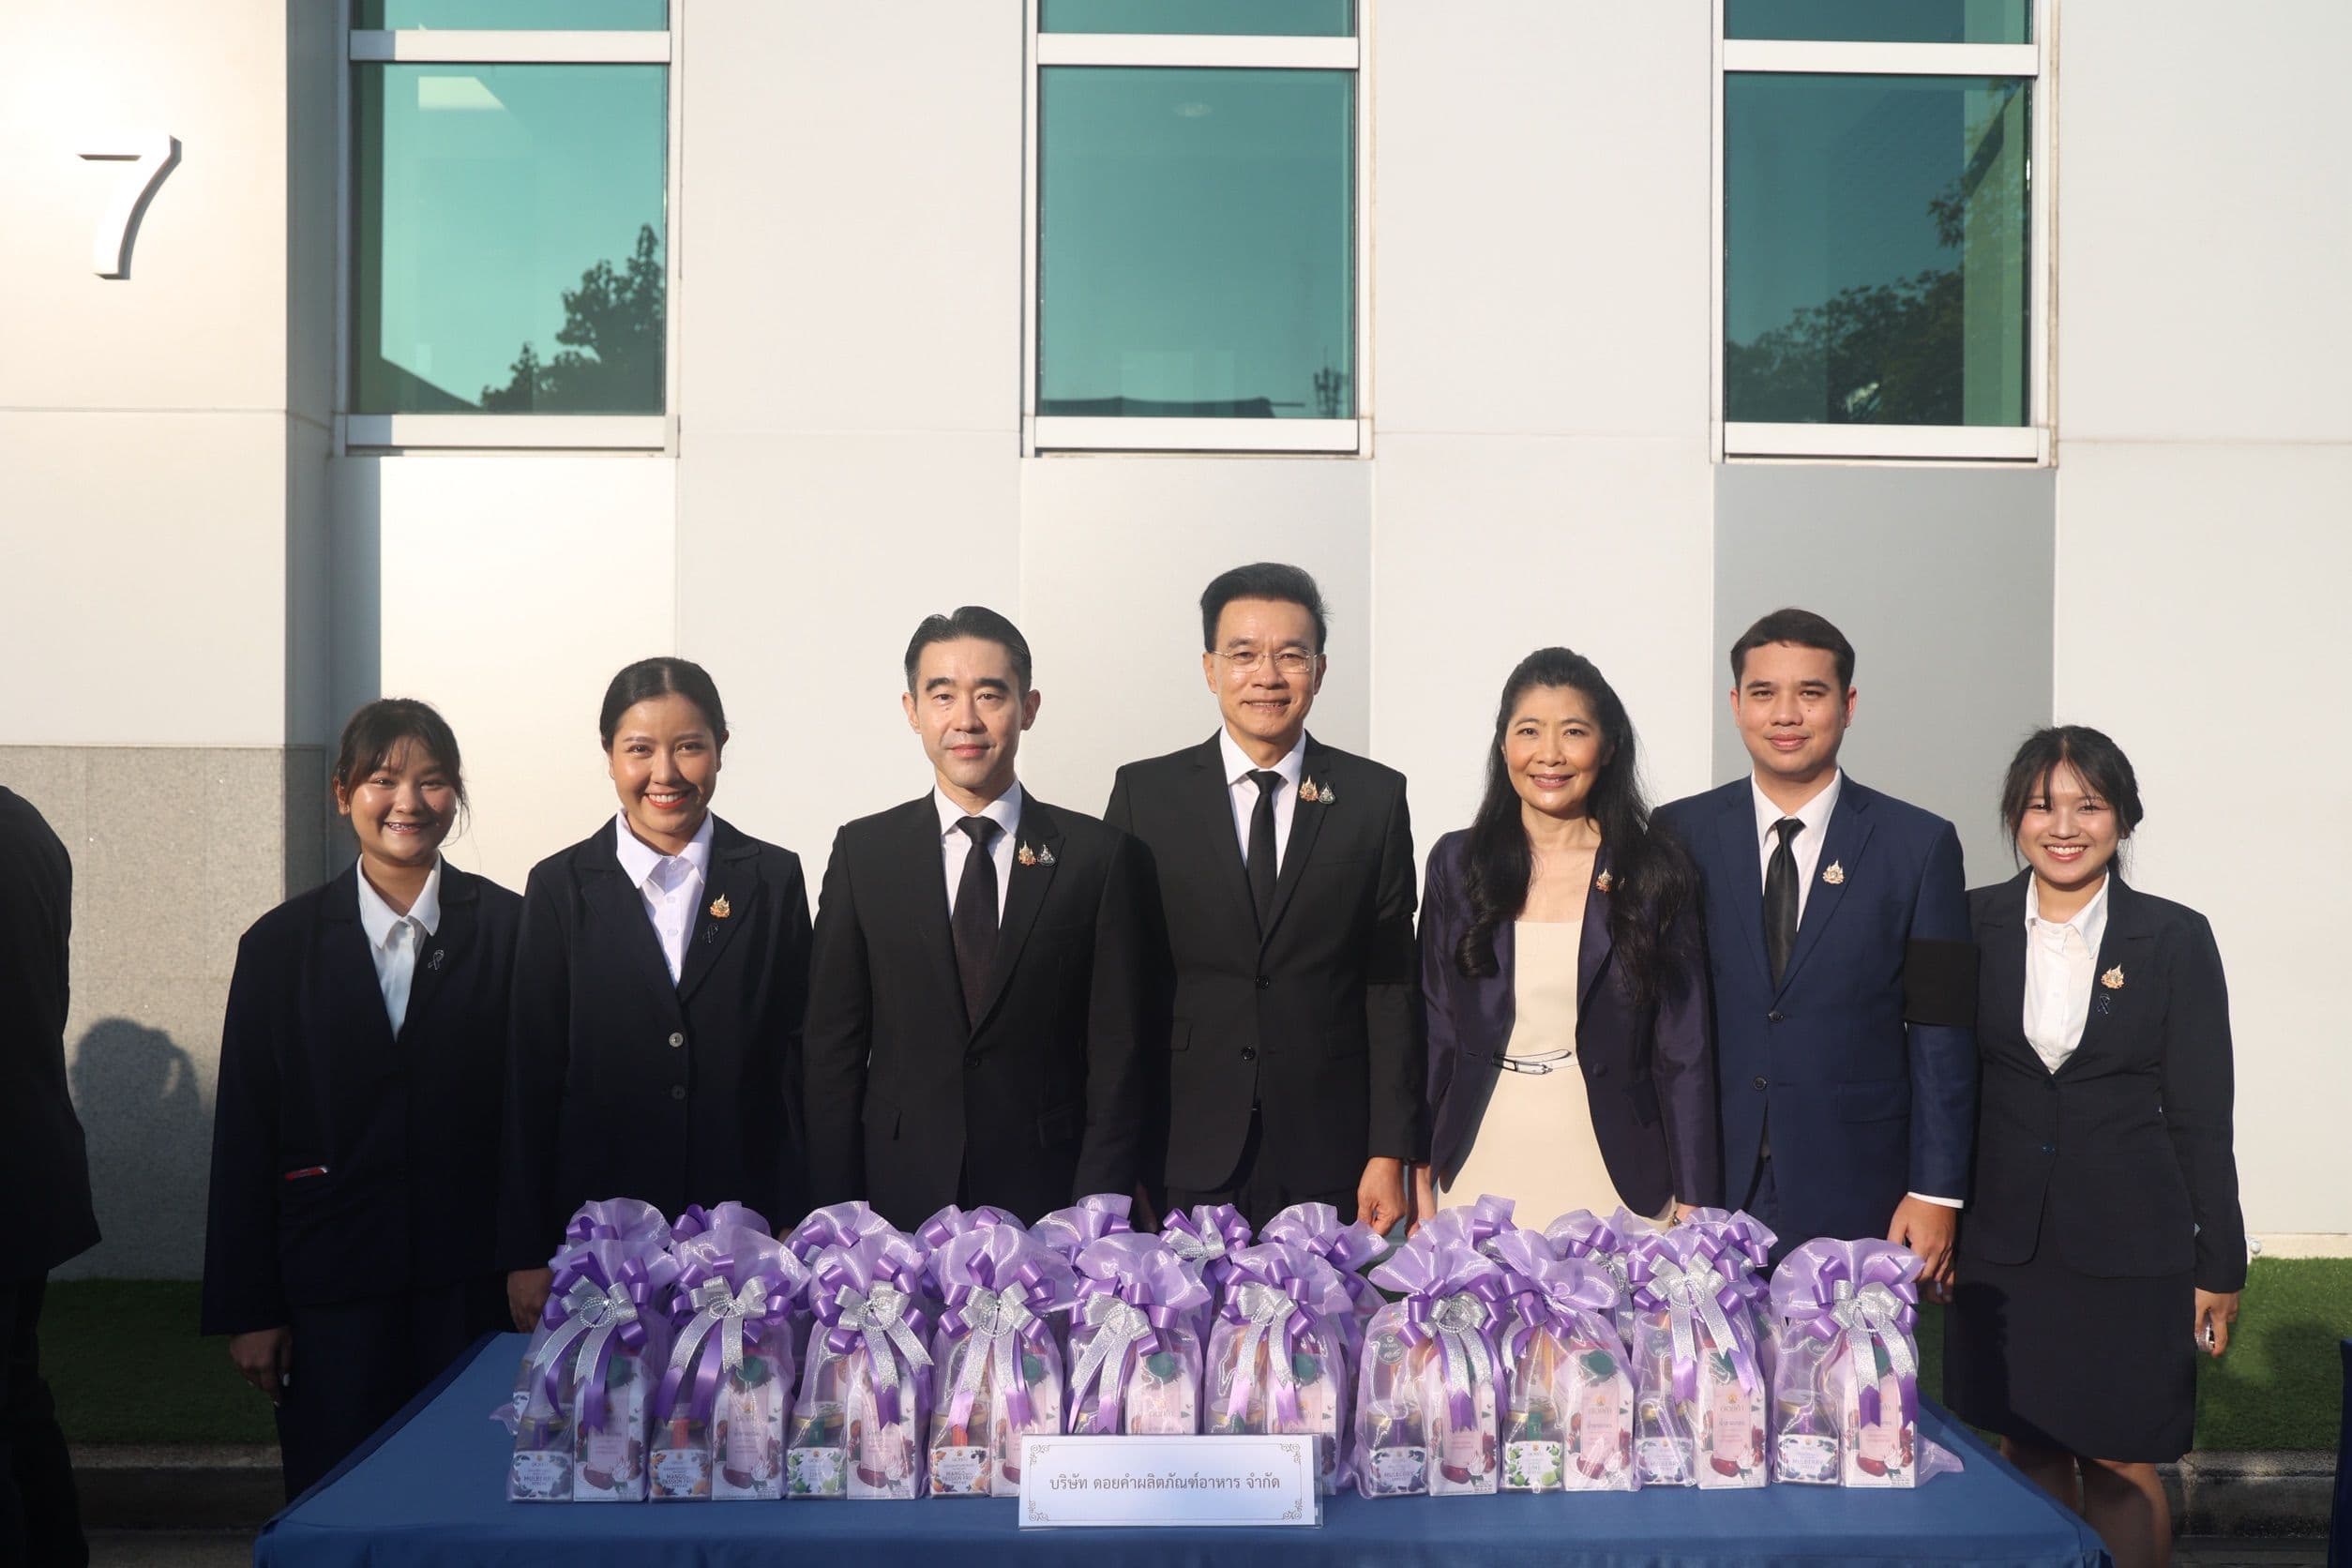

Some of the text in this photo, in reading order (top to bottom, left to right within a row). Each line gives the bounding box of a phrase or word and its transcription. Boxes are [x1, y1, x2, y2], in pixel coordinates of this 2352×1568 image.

[77, 133, 182, 280] 7
[1049, 1471, 1281, 1490] บริษัท ดอยคำผลิตภัณฑ์อาหาร จำกัด
